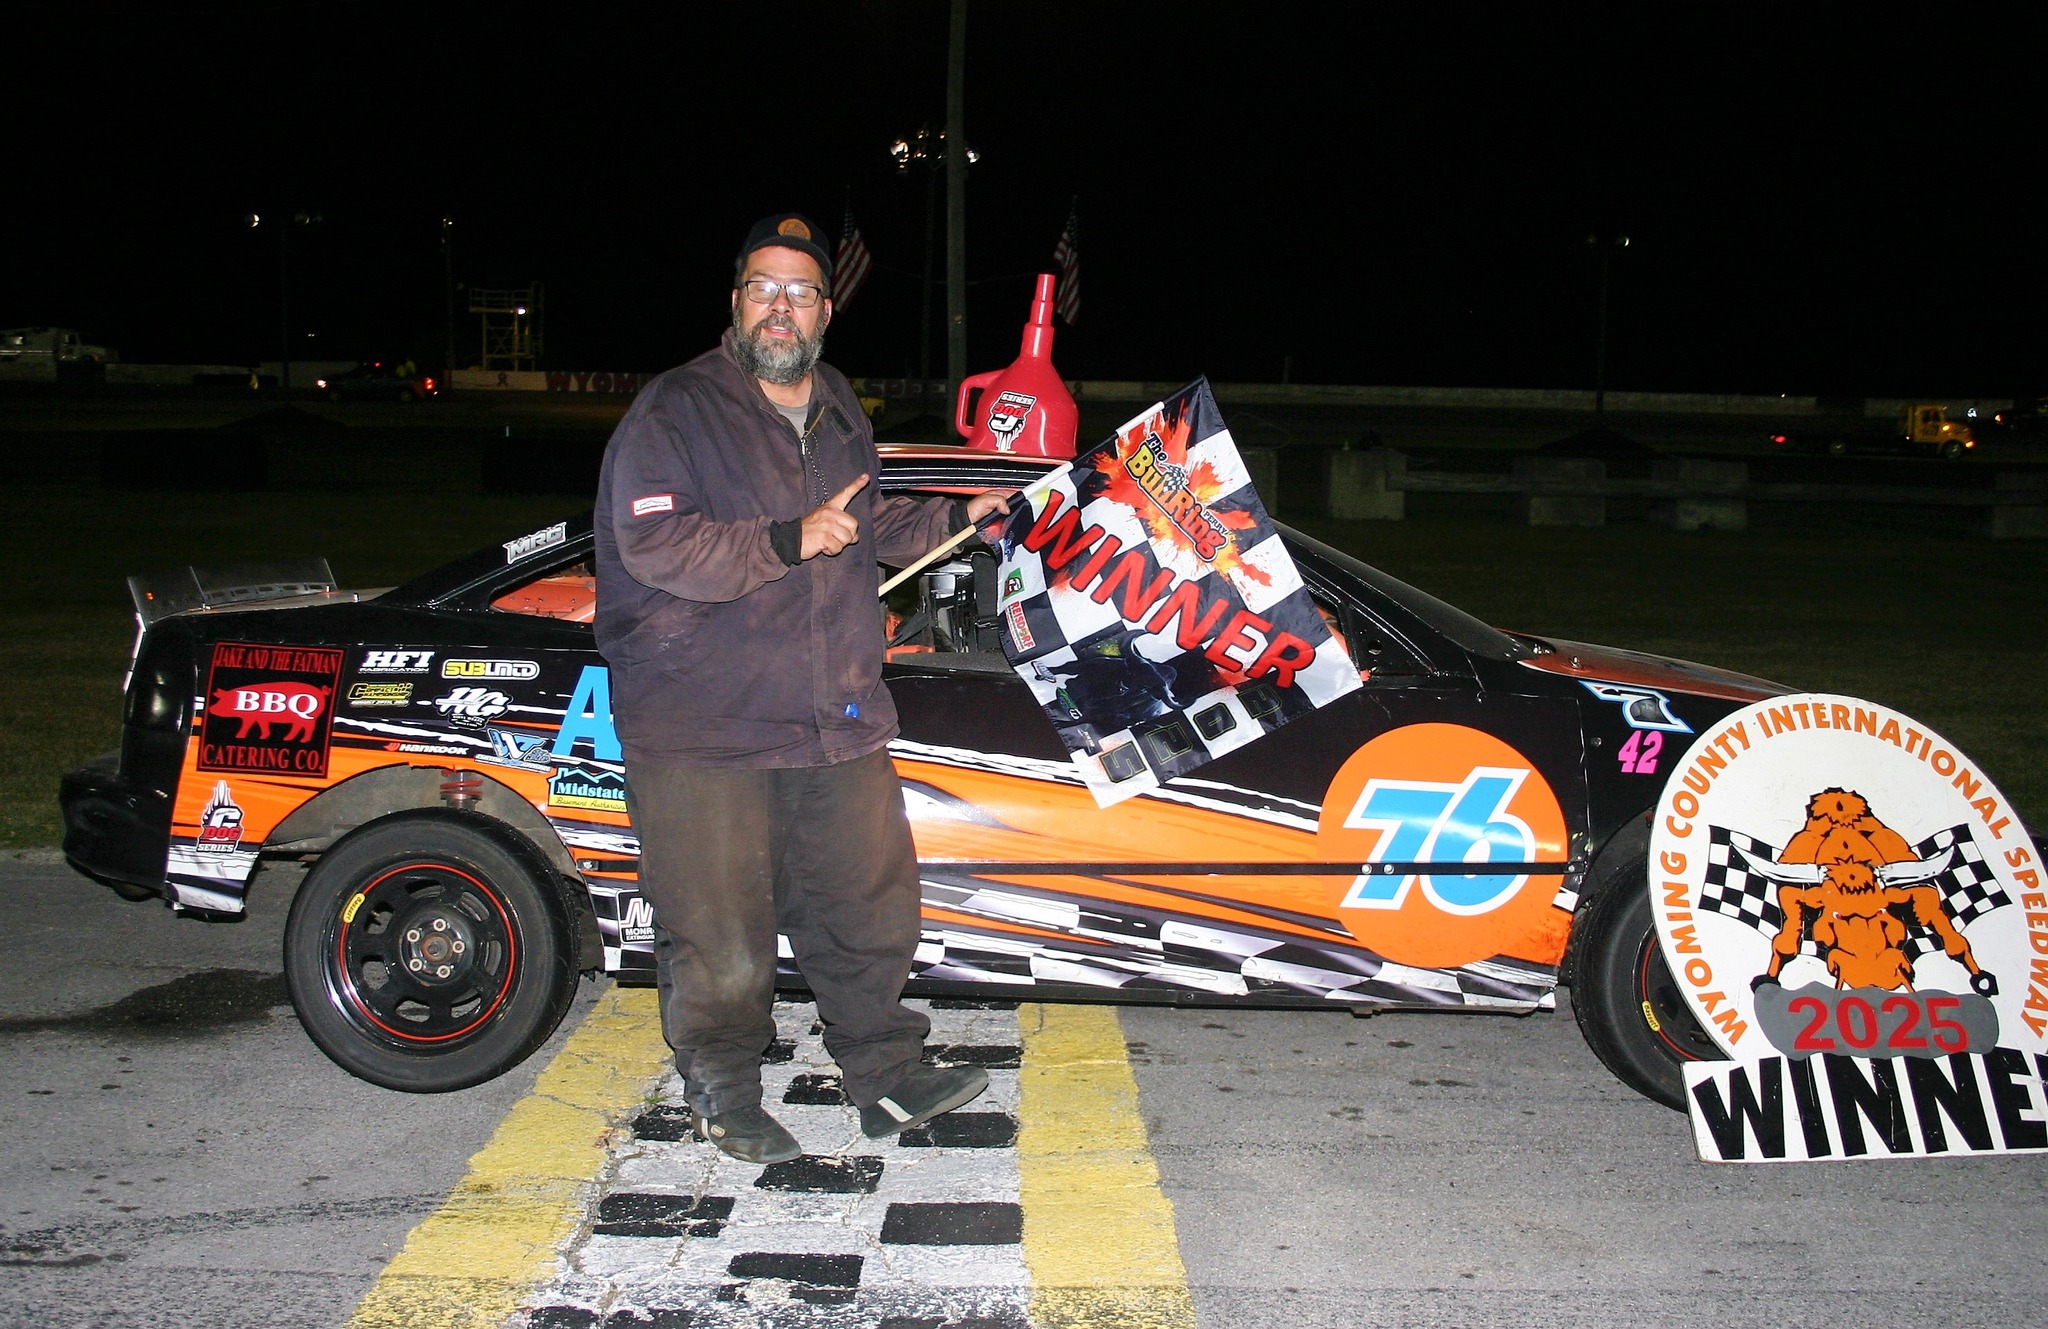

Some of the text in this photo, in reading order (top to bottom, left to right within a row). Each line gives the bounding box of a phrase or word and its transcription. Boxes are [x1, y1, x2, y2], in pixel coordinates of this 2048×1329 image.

[993, 403, 1026, 418] DOG
[1001, 393, 1033, 404] SERIES
[1146, 432, 1168, 461] The
[1125, 441, 1227, 561] BullRing
[1203, 510, 1228, 535] PERRY
[1023, 489, 1316, 689] WINNER
[213, 647, 339, 674] JAKE AND THE FATMAN
[362, 651, 435, 668] HFI
[234, 690, 318, 720] BBQ
[551, 666, 623, 761] A
[203, 744, 325, 770] CATERING CO.
[1618, 730, 1664, 774] 42
[197, 843, 235, 852] SERIES
[203, 826, 241, 840] DOG
[1340, 766, 1536, 917] 76
[1660, 703, 2048, 1046] WYOMING COUNTY INTERNATIONAL SPEEDWAY
[1788, 995, 1967, 1053] 2025
[1692, 1046, 2048, 1160] WINNE
